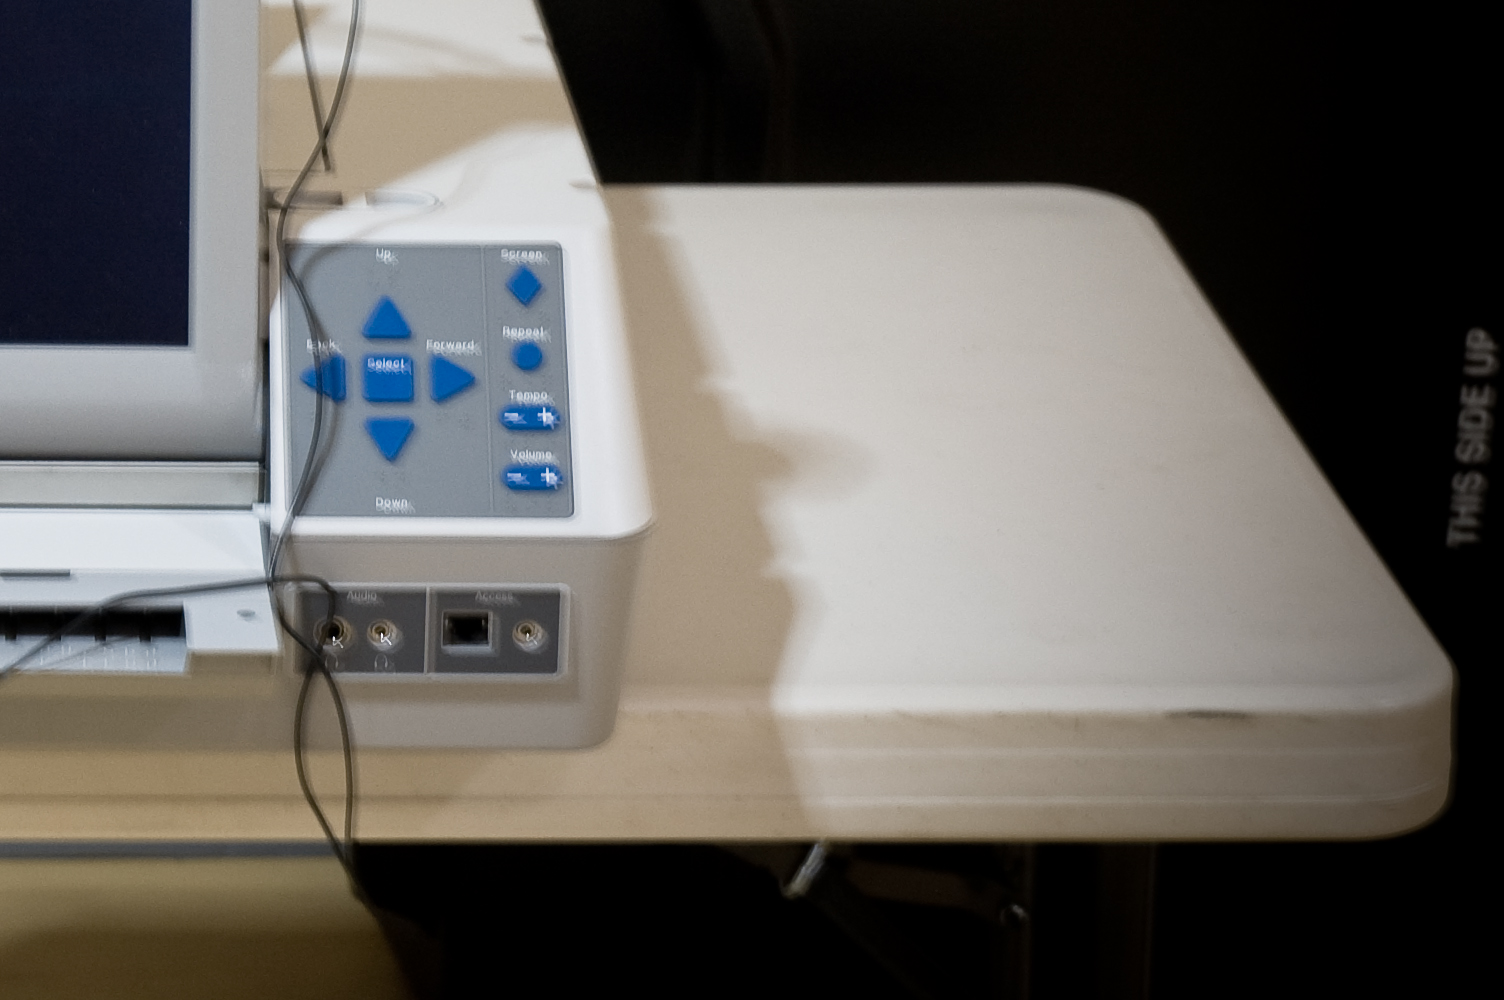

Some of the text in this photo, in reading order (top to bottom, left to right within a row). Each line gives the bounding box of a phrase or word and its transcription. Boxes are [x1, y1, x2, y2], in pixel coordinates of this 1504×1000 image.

[376, 249, 396, 264] Up
[501, 248, 545, 263] Screen
[502, 325, 547, 341] Repeat
[426, 339, 477, 354] Forward
[367, 357, 408, 373] Select
[509, 390, 550, 405] Tempo
[1446, 327, 1498, 548] THIS SIDE UP
[510, 450, 554, 464] Volume
[376, 497, 411, 512] Down
[347, 590, 380, 604] Audio
[475, 590, 516, 604] Access
